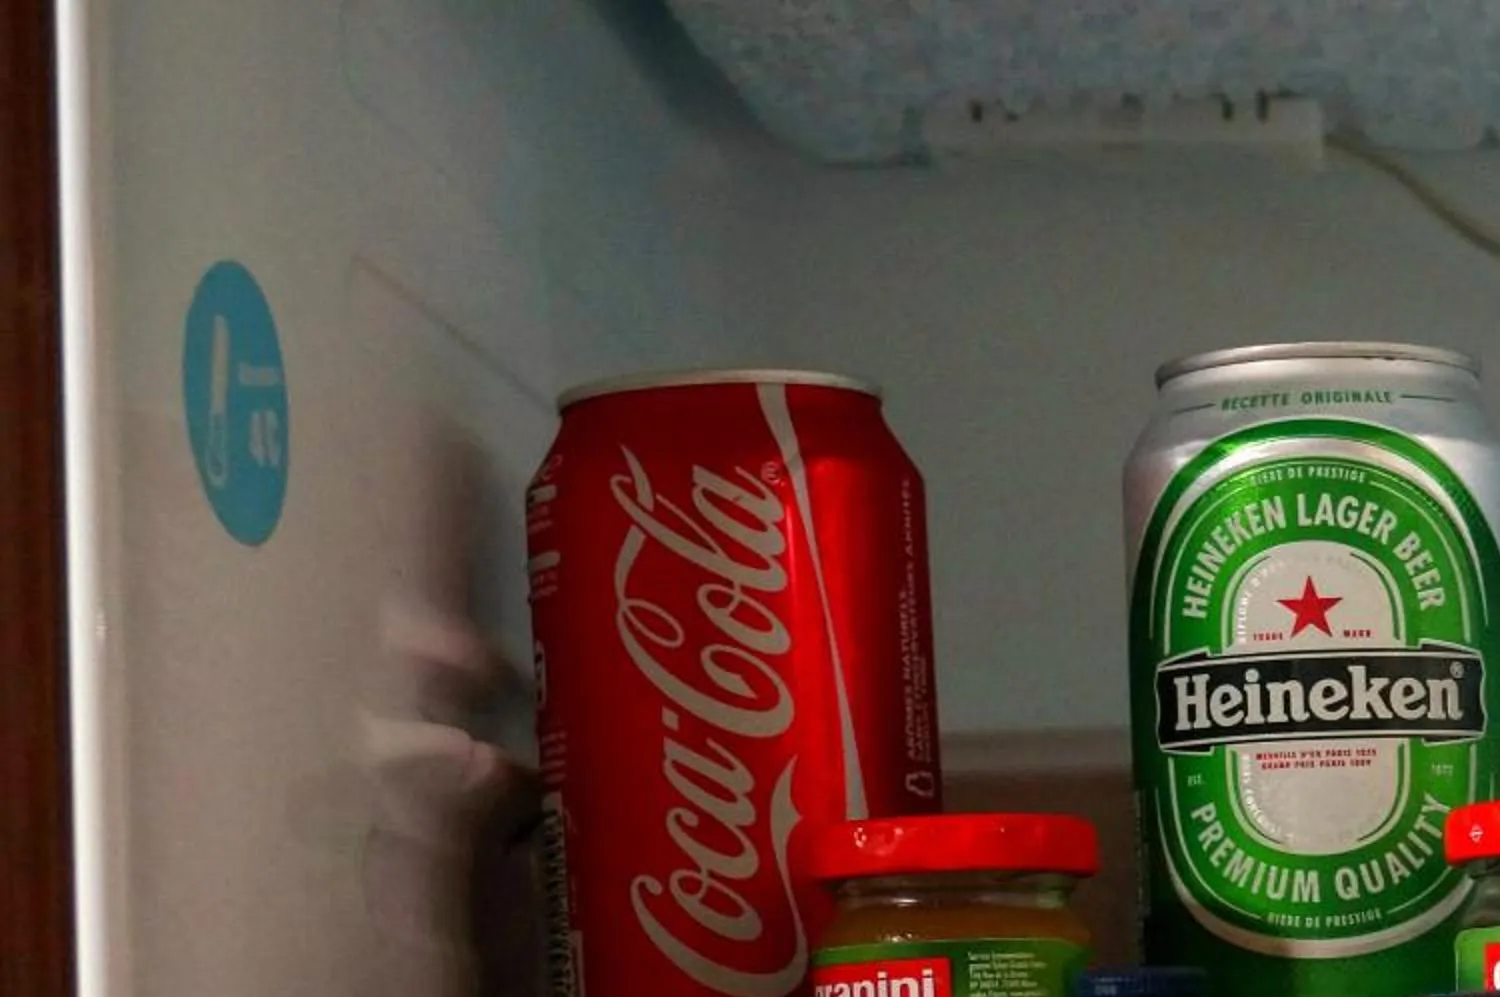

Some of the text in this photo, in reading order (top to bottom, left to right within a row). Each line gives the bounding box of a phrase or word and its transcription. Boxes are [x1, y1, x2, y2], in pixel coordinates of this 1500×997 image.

[1221, 390, 1397, 411] RECETTE ORIGINALE
[1182, 495, 1289, 620] HEINEKEN
[1296, 492, 1398, 546] LAGER
[1392, 530, 1447, 611] BEER
[1173, 663, 1464, 731] Heineken
[1190, 801, 1321, 904] PREMIUM
[1334, 792, 1453, 903] QUALITY
[1324, 908, 1385, 928] PRESTIGE
